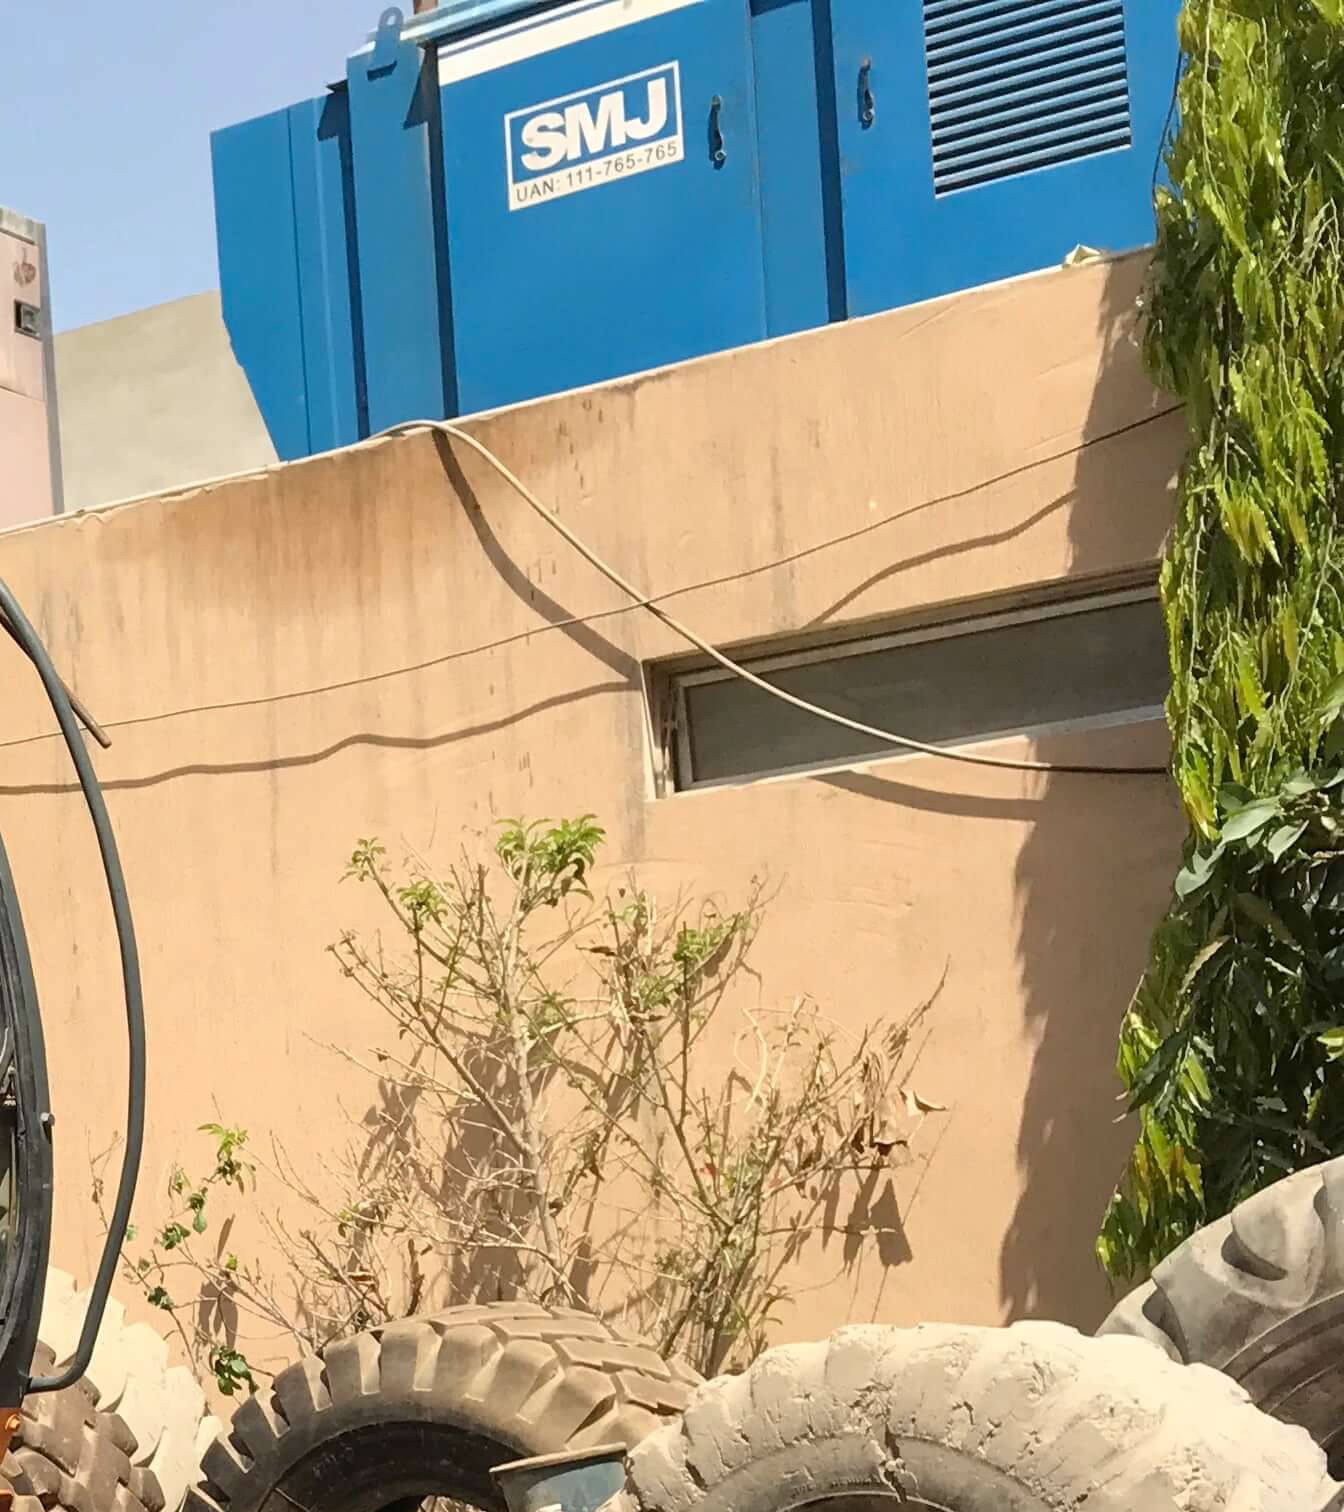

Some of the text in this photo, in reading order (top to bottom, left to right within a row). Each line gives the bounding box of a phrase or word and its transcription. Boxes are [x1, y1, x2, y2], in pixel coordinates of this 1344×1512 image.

[521, 77, 668, 171] SMJ
[516, 141, 678, 203] UAN: 111-765-765
